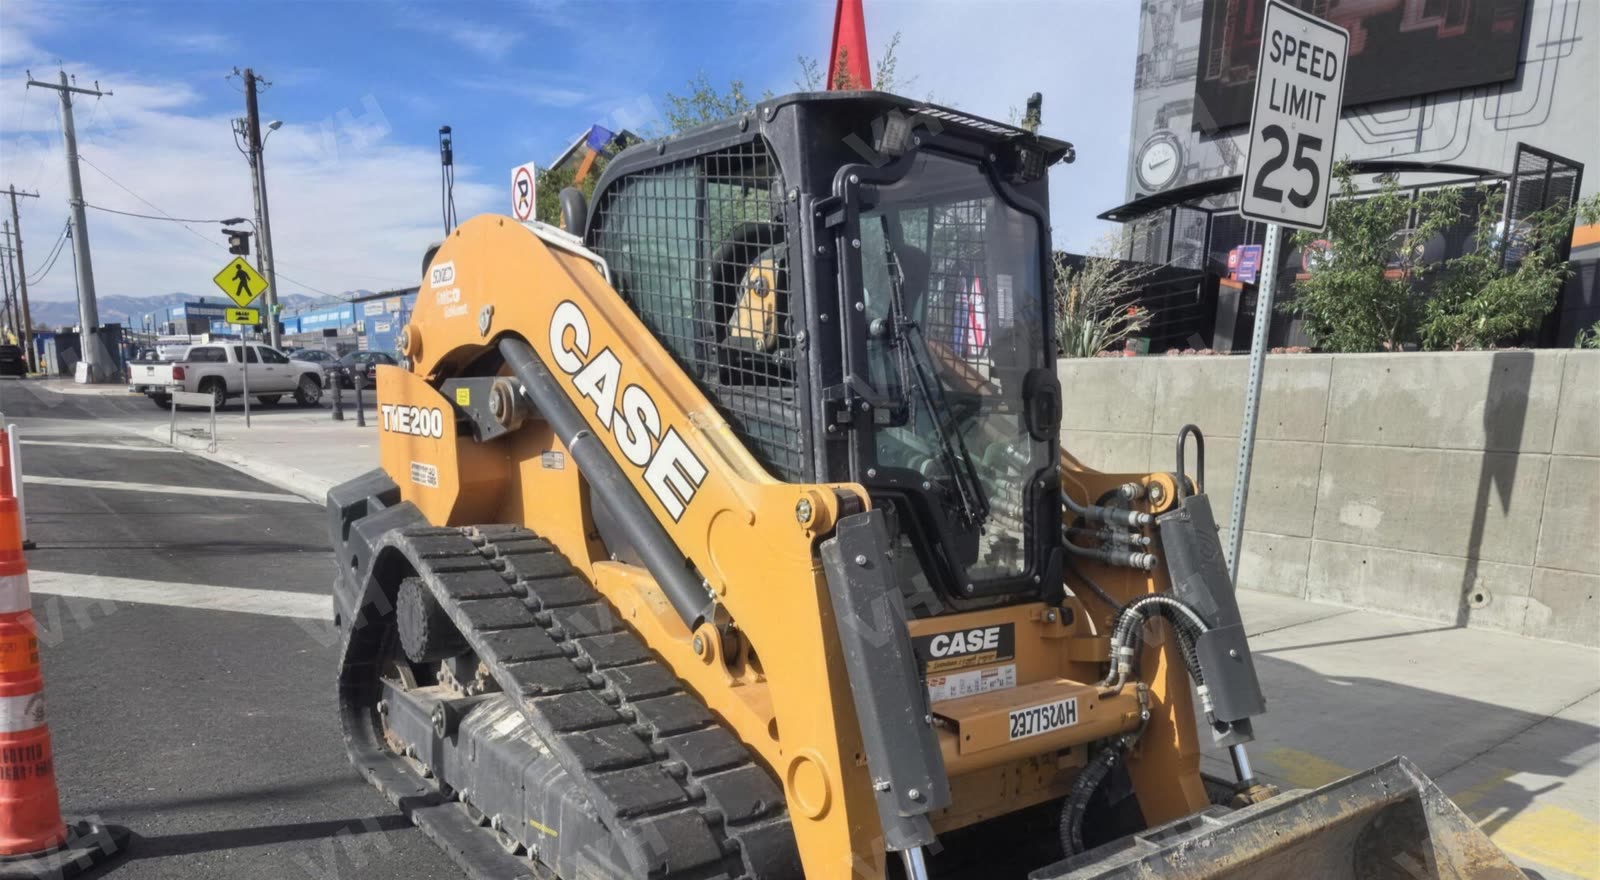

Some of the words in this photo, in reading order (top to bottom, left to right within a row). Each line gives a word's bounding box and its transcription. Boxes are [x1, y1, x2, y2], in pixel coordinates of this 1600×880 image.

[1269, 30, 1338, 82] SPEED
[1269, 78, 1326, 124] LIMIT
[1252, 124, 1323, 209] 25
[549, 299, 709, 524] CASE
[929, 627, 1000, 657] CASE
